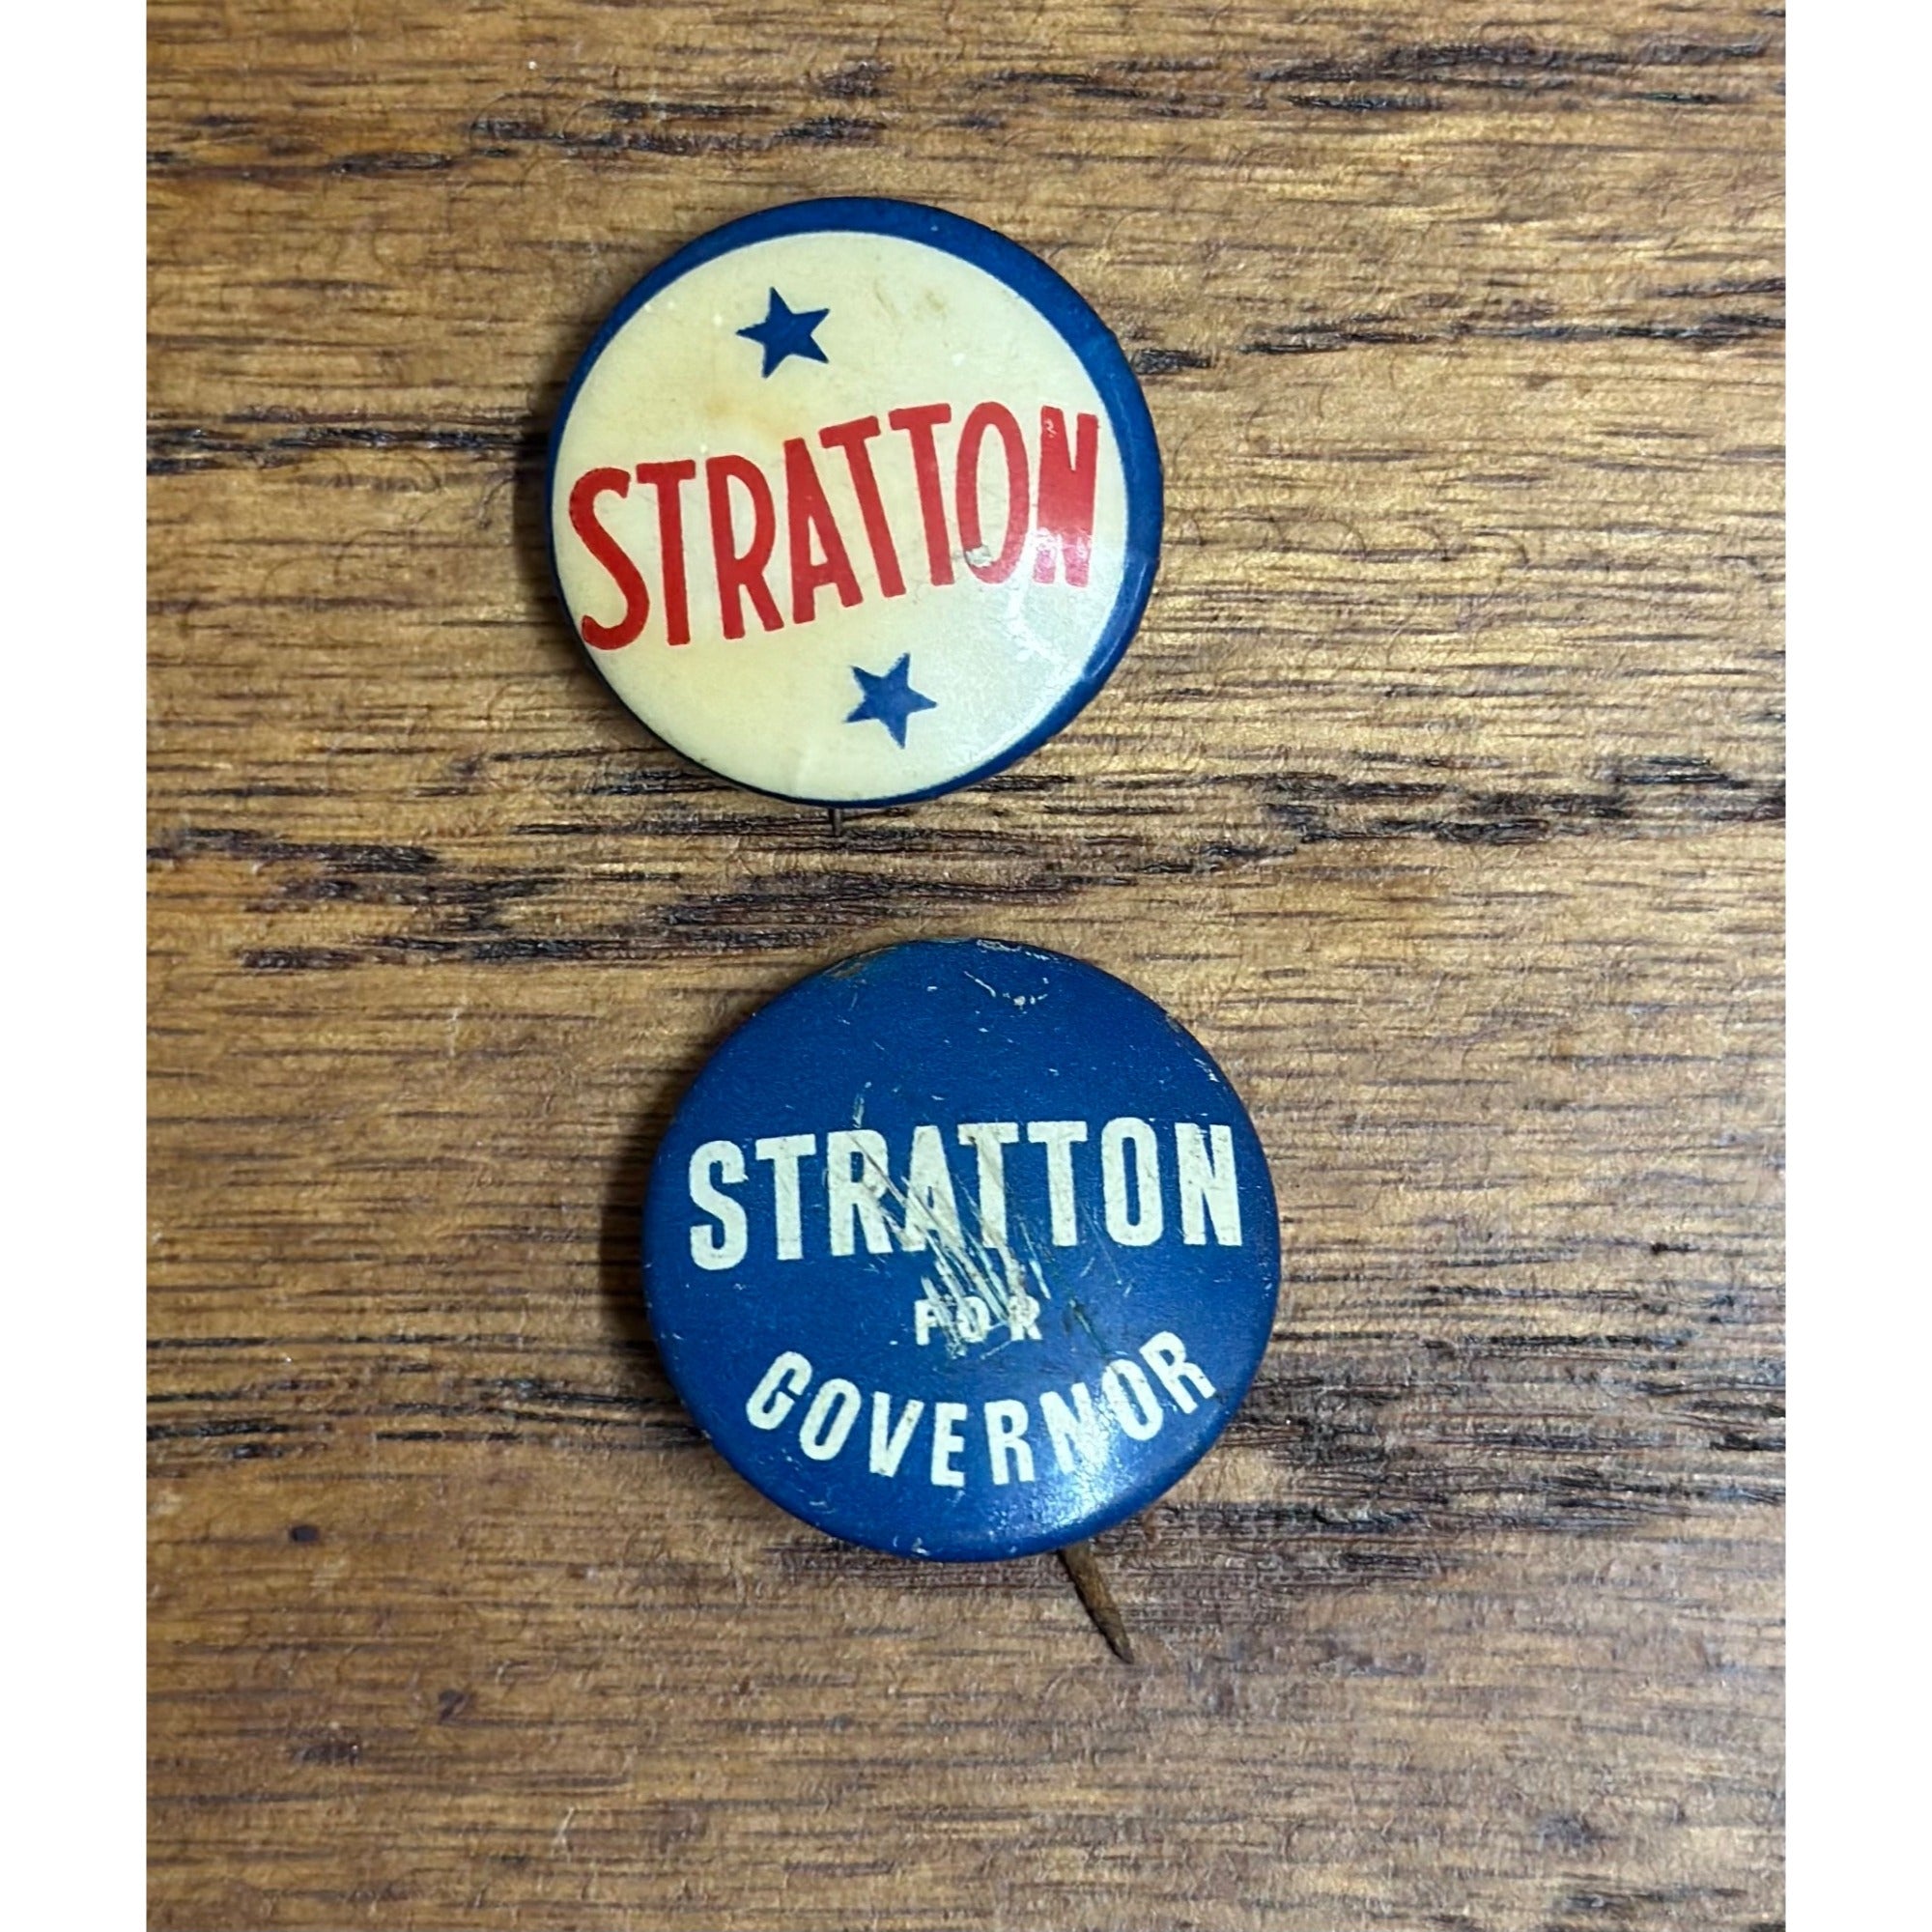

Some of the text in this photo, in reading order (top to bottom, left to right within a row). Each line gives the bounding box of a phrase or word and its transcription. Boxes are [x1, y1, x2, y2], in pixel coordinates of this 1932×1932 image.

[569, 401, 1098, 650] STRATTON
[688, 1116, 1243, 1271] STRATTON
[914, 1294, 1043, 1346] FOR
[745, 1330, 1216, 1487] GOVERNOR
